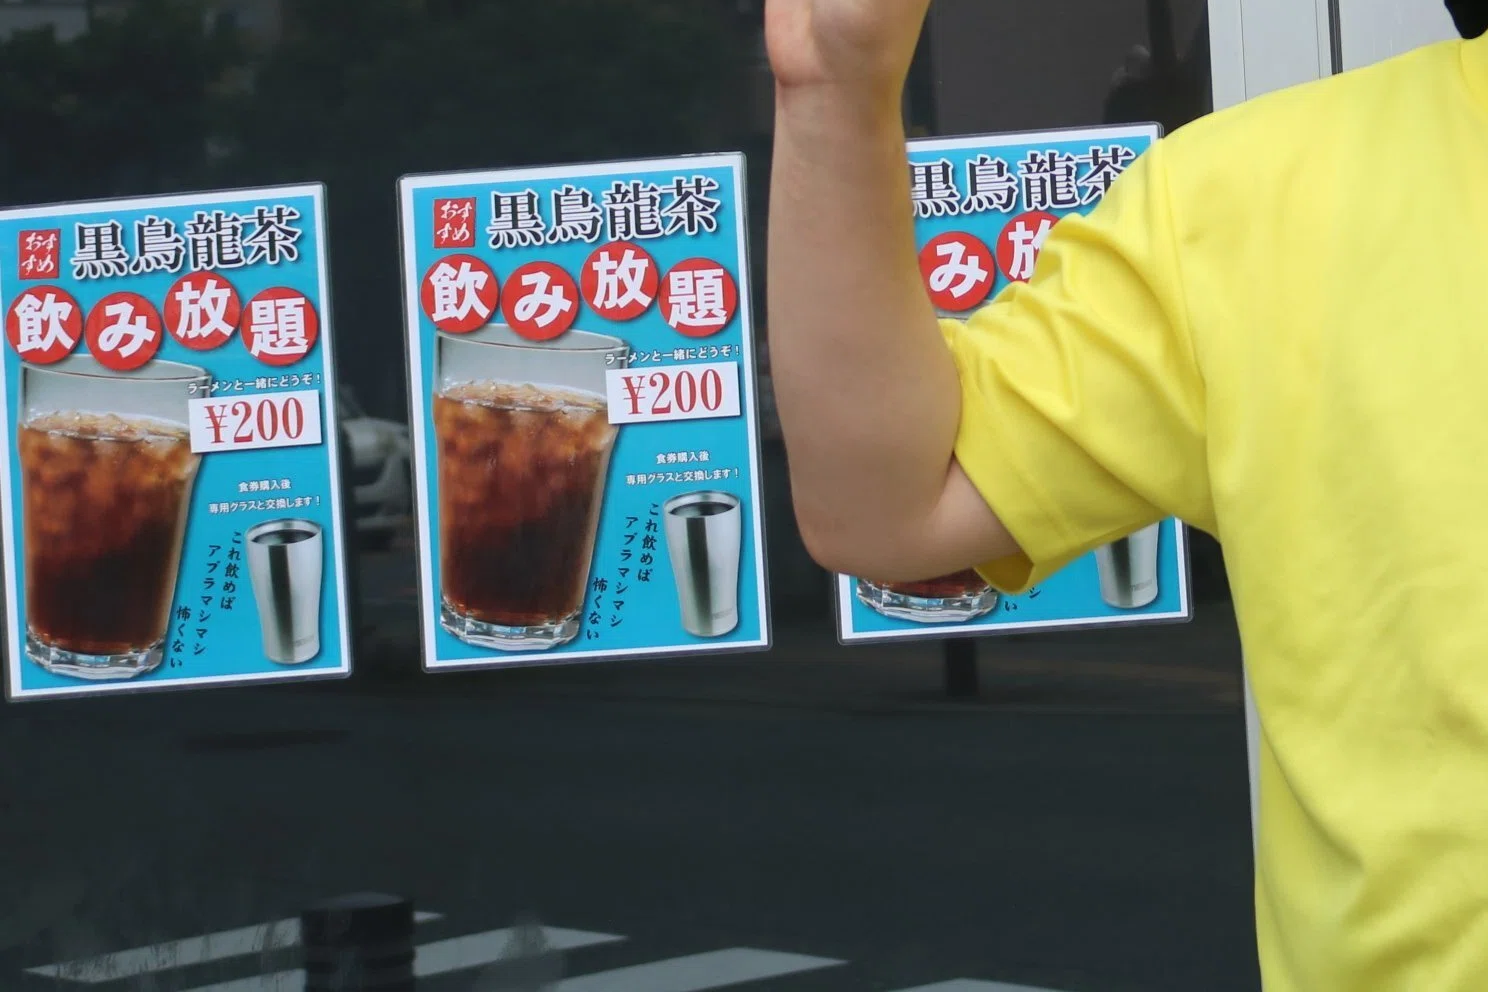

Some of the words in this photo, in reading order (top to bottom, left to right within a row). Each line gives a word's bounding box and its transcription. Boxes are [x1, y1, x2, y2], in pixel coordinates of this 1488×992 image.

[14, 278, 309, 358] 飲み放題
[428, 249, 728, 328] 飲み放題
[203, 397, 304, 444] ¥200
[621, 368, 723, 415] ¥200
[220, 531, 243, 610] これ飲めば
[610, 516, 639, 628] アブラマシマシ
[637, 503, 661, 583] これ飲めば
[170, 605, 191, 668] 怖くない
[193, 544, 222, 656] アブラマシマシ
[586, 577, 608, 640] 怖くない
